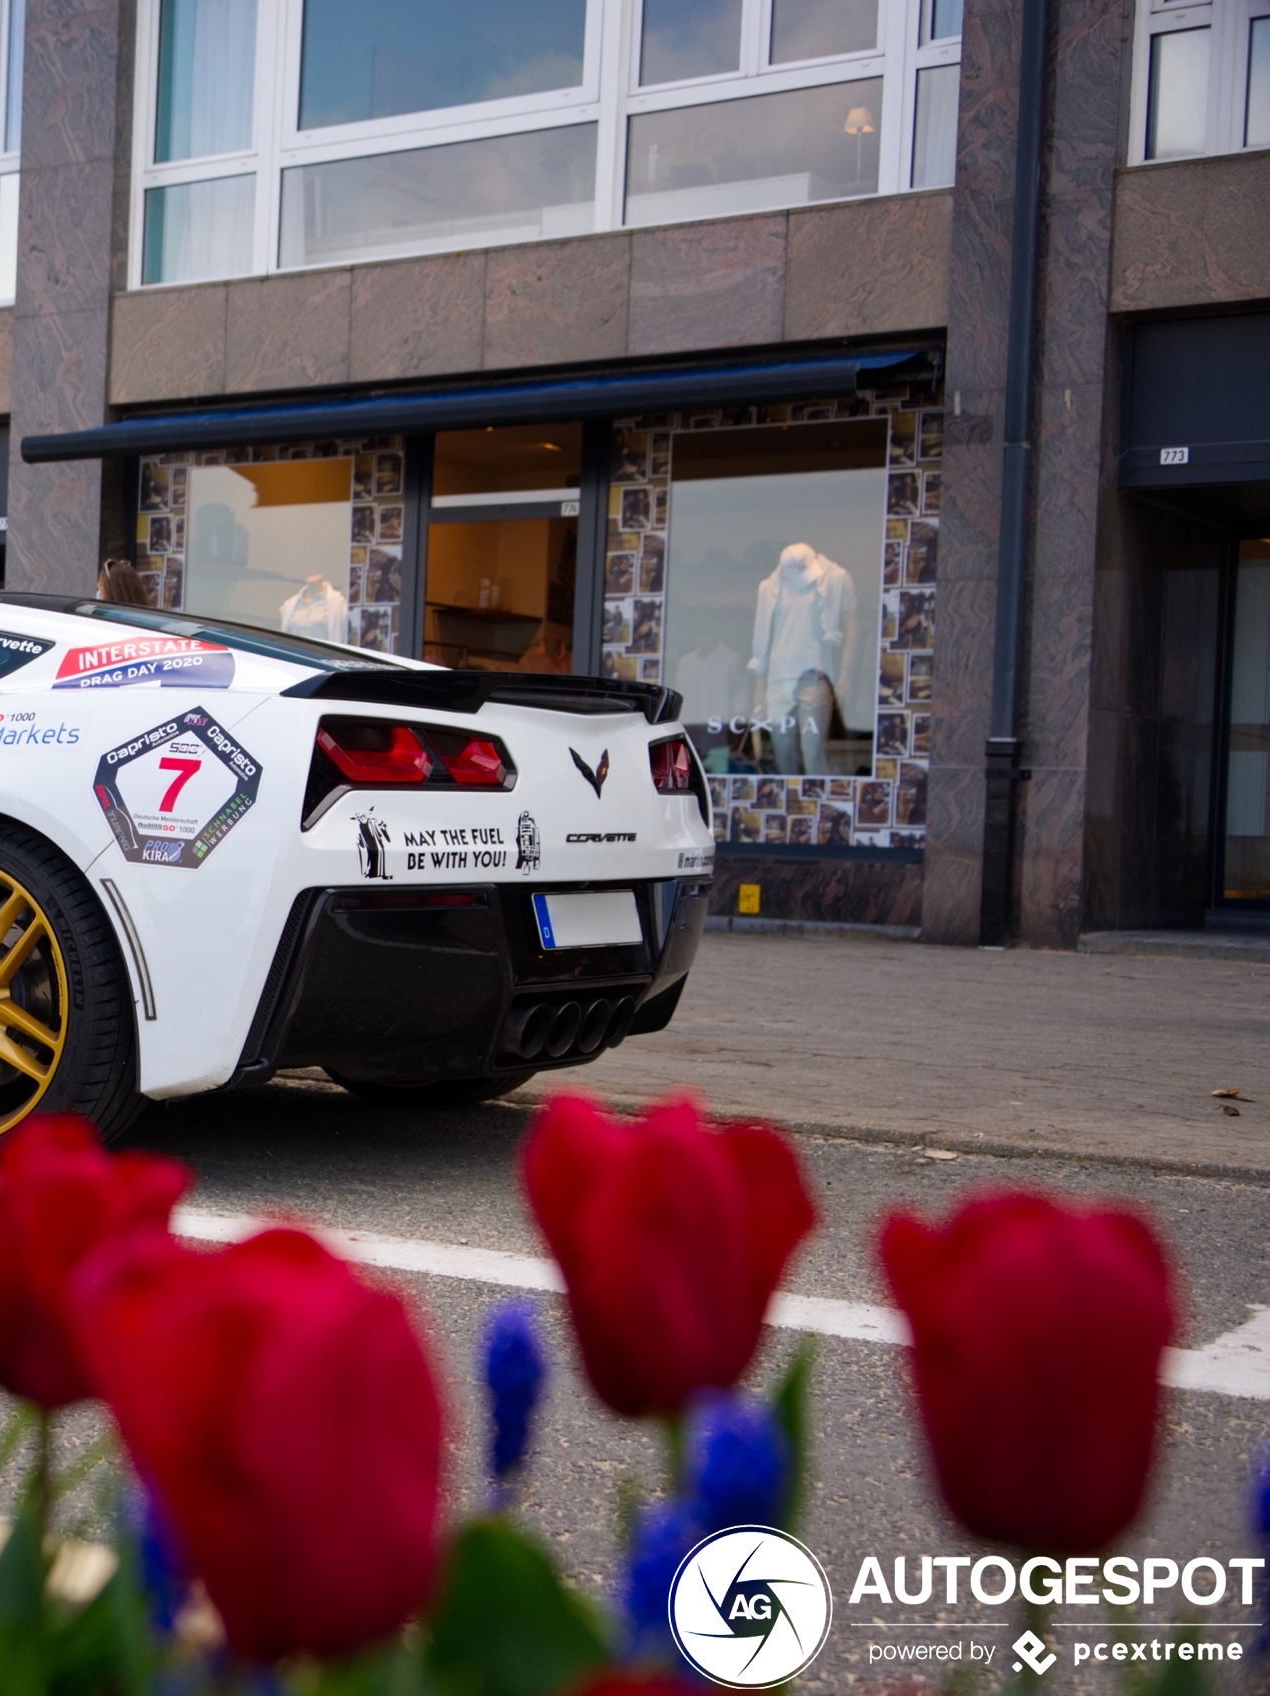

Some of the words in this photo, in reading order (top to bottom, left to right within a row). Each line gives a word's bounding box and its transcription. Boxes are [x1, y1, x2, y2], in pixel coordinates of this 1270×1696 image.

[1163, 450, 1185, 463] 773
[78, 639, 204, 671] INTERSTATE
[80, 671, 123, 688] DRAG
[127, 662, 159, 679] DAY
[162, 656, 204, 672] 2020
[106, 722, 178, 764] Capristo
[206, 725, 257, 776] Capristo
[158, 757, 203, 813] 7
[203, 793, 248, 838] SCHNABEL
[209, 797, 253, 845] WERBUNG
[145, 840, 169, 852] PRO
[403, 830, 436, 847] MAY
[440, 829, 469, 846] THE
[471, 828, 505, 845] FUEL
[566, 833, 637, 843] CORVETTE
[142, 849, 169, 862] KIRA
[407, 853, 425, 870] BE
[430, 852, 468, 869] WITH
[472, 851, 507, 868] YOU!
[543, 927, 550, 938] D
[57, 916, 84, 1004] MICHELIN
